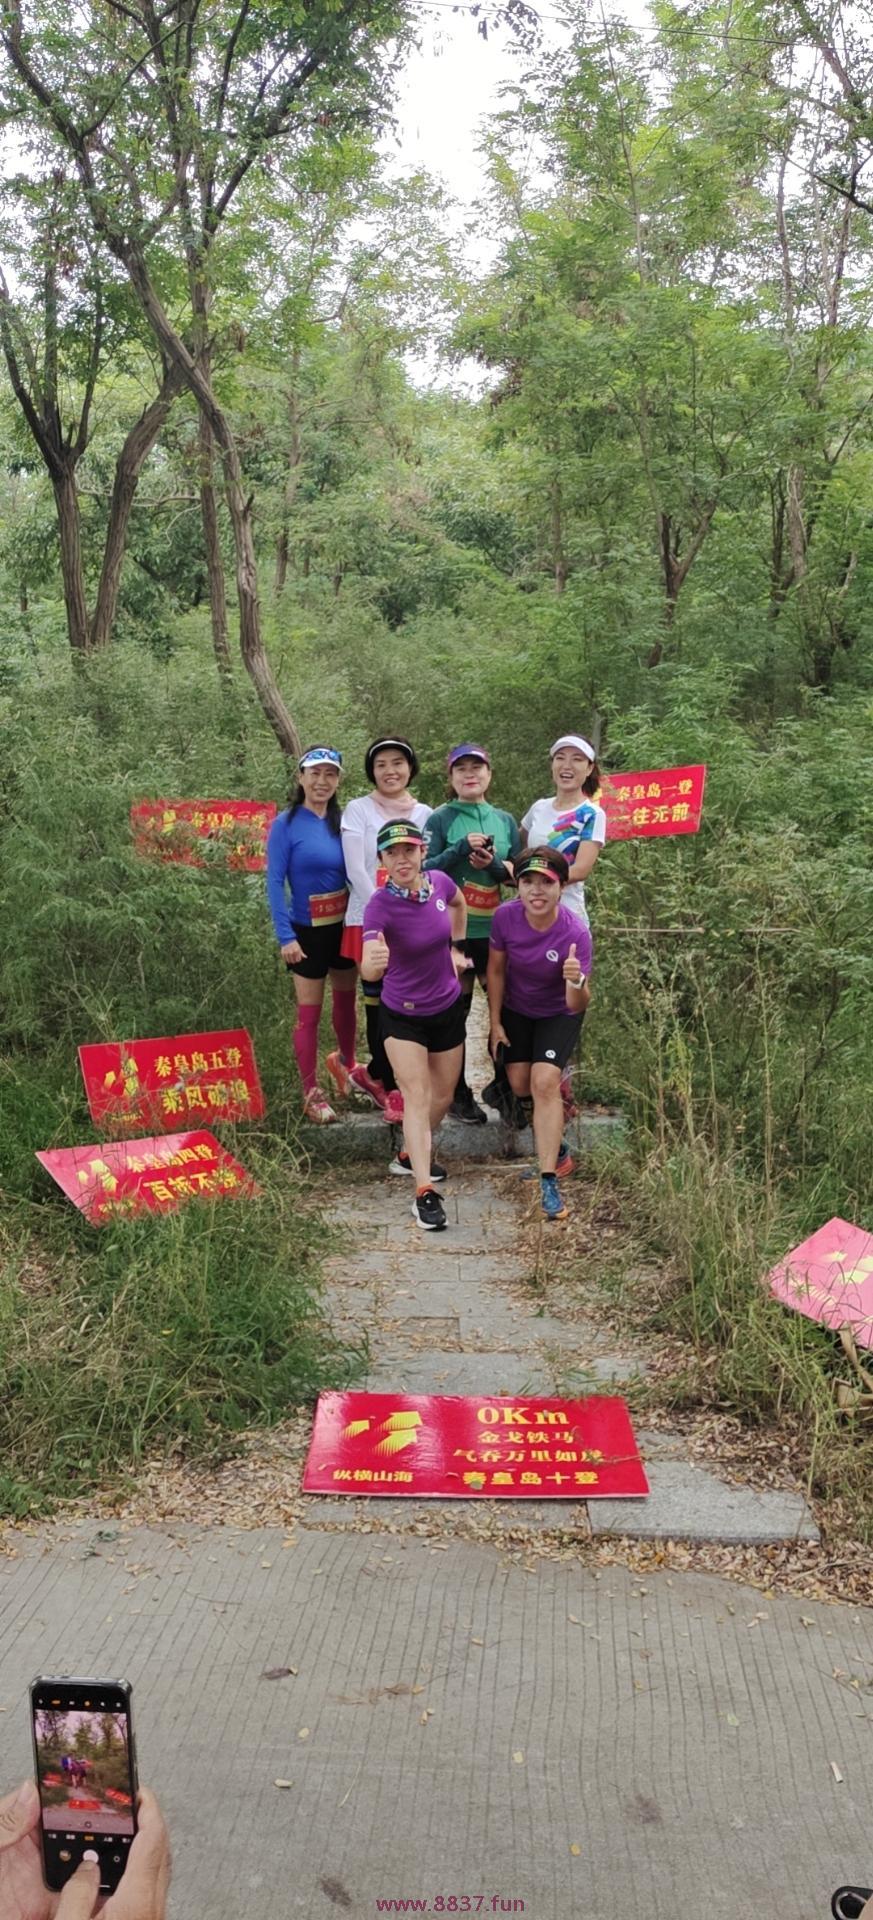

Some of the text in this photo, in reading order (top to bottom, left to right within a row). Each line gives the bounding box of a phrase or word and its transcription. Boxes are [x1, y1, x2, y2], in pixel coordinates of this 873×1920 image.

[616, 778, 693, 802] 秦皇岛一登
[155, 1047, 243, 1077] 秦皇岛五登
[125, 1143, 218, 1173] 秦皇岛四登
[478, 1430, 574, 1444] 金戈铁马
[453, 1449, 604, 1463] 气吞万里如虎
[333, 1469, 413, 1483] 纵横山海
[462, 1471, 600, 1485] 秦皇岛十登
